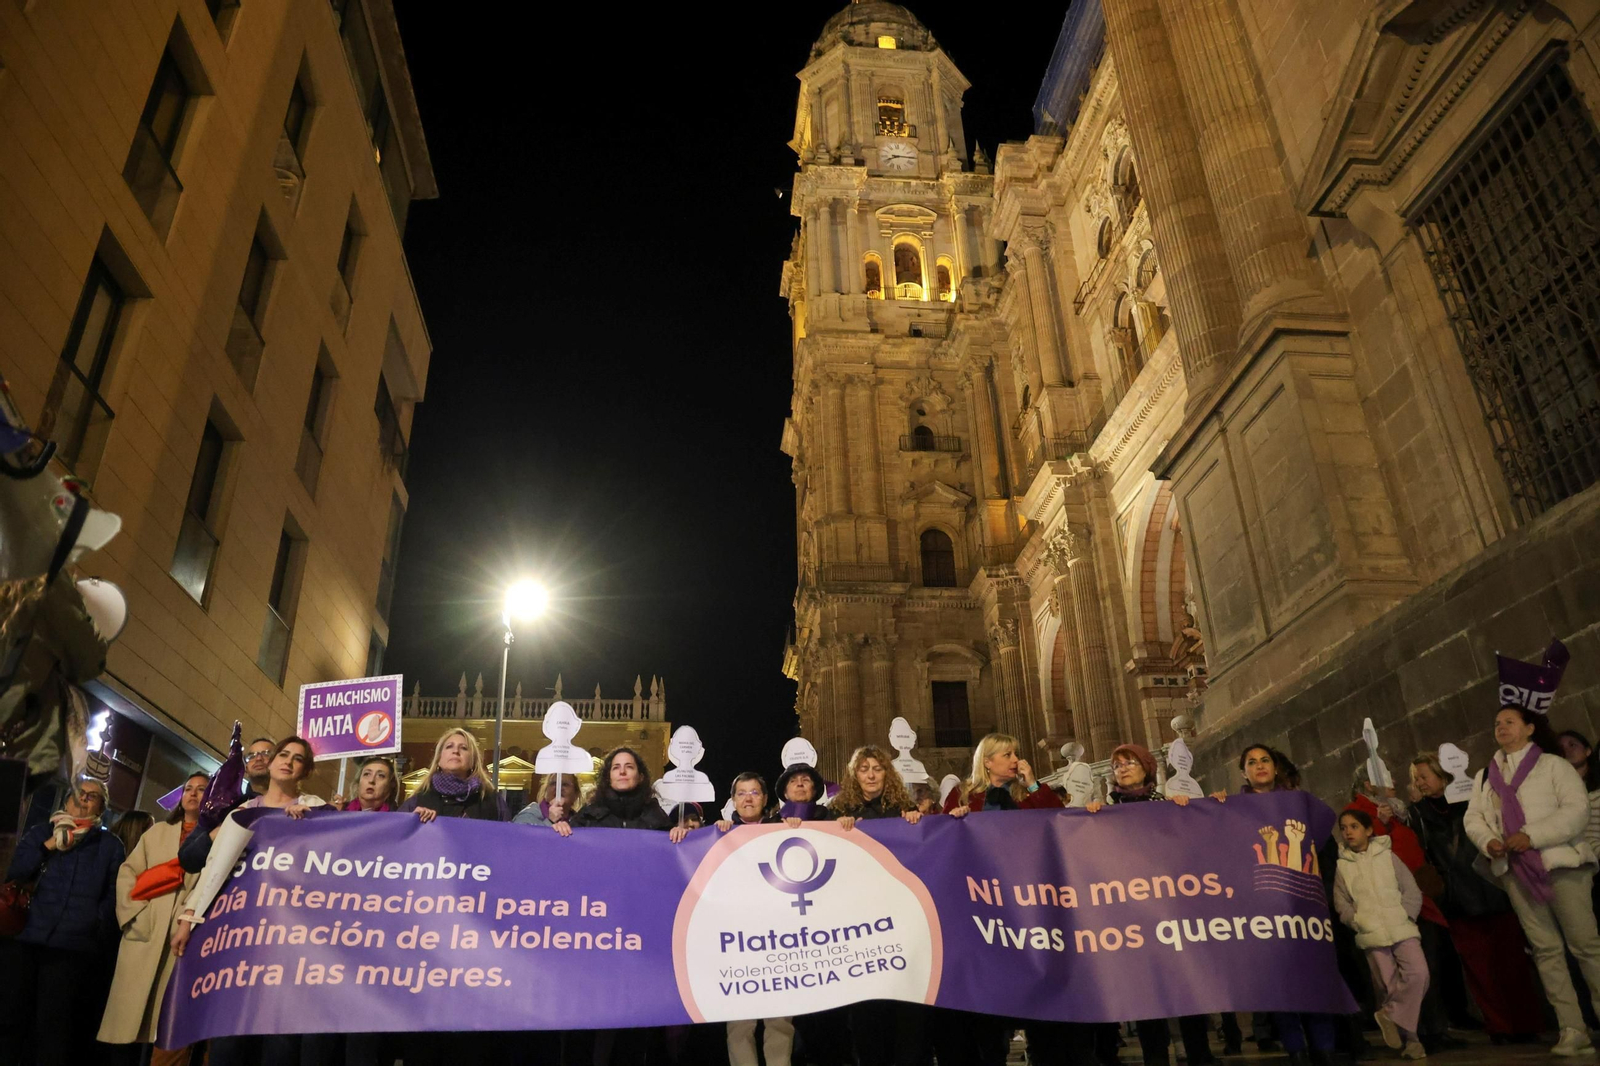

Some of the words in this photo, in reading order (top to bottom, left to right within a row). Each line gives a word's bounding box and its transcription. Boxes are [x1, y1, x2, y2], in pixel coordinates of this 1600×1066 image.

[309, 694, 324, 709] EL
[325, 687, 391, 708] MACHISMO
[308, 713, 354, 739] MATA
[251, 846, 294, 871] de
[303, 850, 491, 881] Noviembre
[209, 886, 248, 920] Día
[256, 882, 487, 914] Internacional
[495, 897, 570, 920] para
[580, 895, 608, 917] la
[966, 875, 1004, 906] Ni
[1013, 884, 1079, 909] una
[1089, 872, 1235, 906] menos,
[200, 918, 385, 958] eliminación
[396, 924, 440, 950] de
[450, 924, 479, 950] la
[489, 924, 642, 951] violencia
[719, 916, 895, 953] Plataforma
[972, 915, 1065, 952] Vivas
[1074, 924, 1144, 953] nos
[1155, 914, 1334, 952] queremos
[718, 961, 809, 979] violencias
[814, 943, 903, 971] machistas
[765, 945, 822, 963] contra
[826, 943, 850, 957] las
[191, 960, 284, 999] contra
[294, 957, 346, 986] las
[355, 960, 512, 994] mujeres.
[718, 970, 841, 996] VIOLENCIA
[847, 955, 908, 978] CERO
